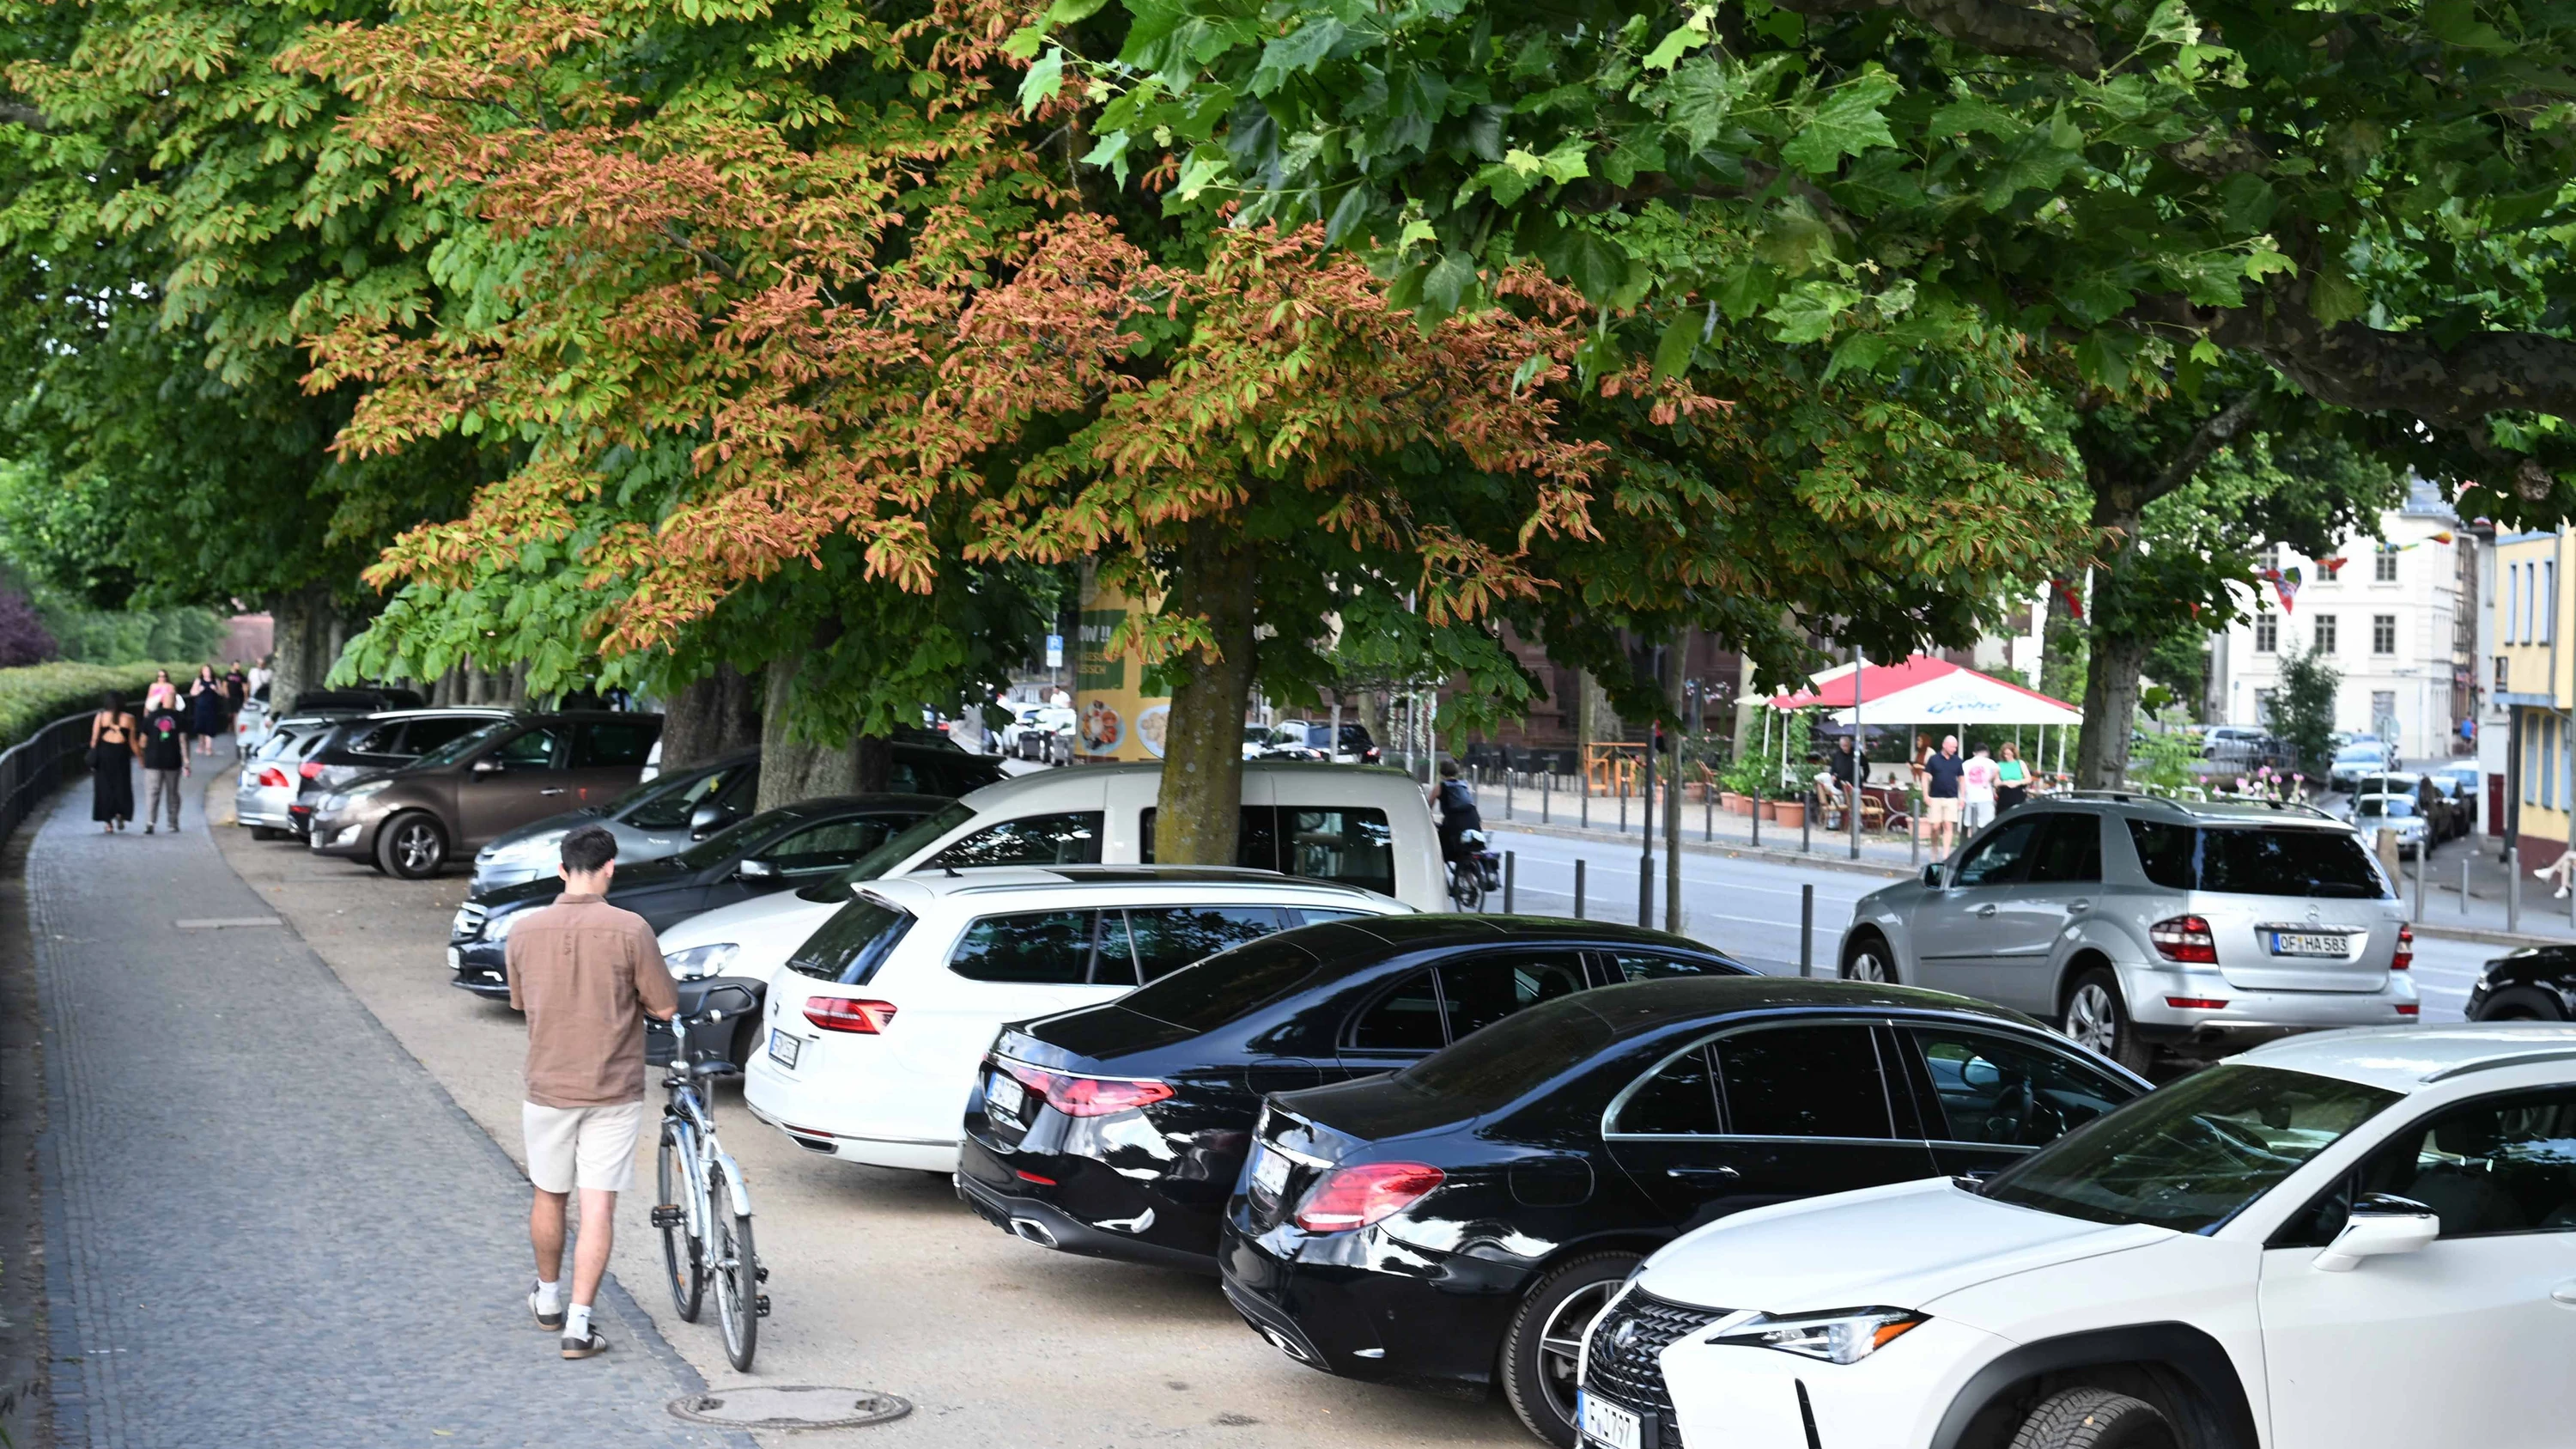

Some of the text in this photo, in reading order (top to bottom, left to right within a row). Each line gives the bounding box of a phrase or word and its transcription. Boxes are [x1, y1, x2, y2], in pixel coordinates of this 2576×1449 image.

[2281, 935, 2348, 953] OF HA 583
